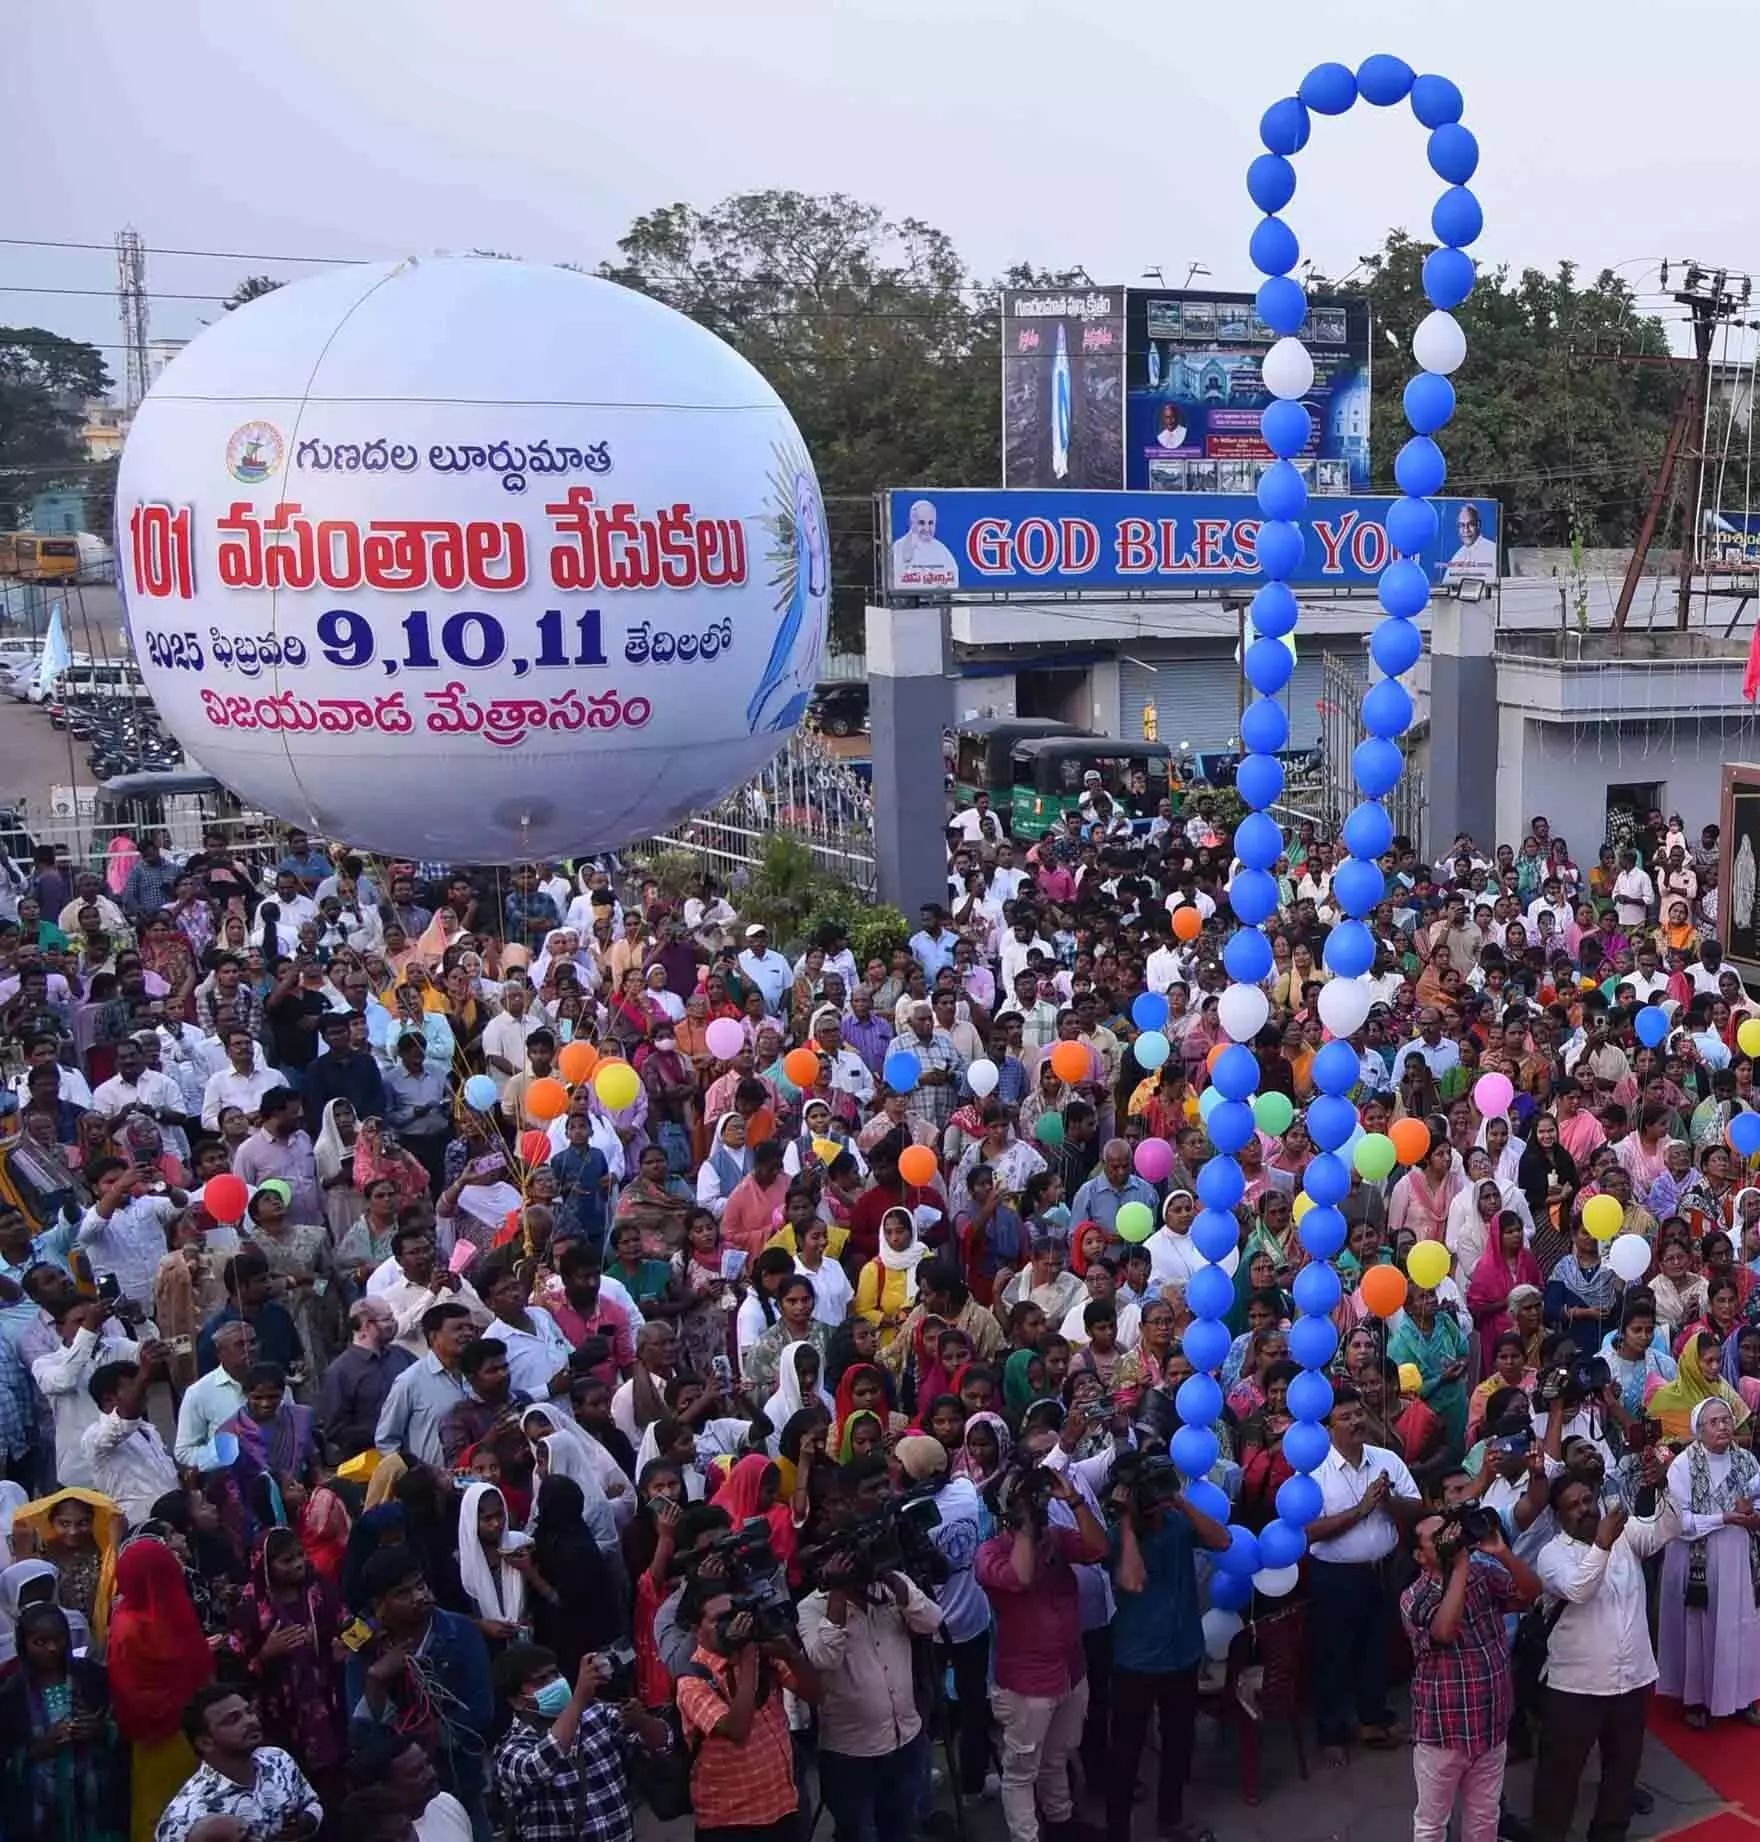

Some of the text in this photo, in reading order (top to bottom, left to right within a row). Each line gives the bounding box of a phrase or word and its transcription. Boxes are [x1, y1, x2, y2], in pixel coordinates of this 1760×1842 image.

[297, 438, 418, 472] గుణదల
[429, 439, 612, 492] లూర్దుమాత
[130, 485, 747, 600] 101 వసంతాల వేడుకలు
[966, 509, 1420, 576] GOD BLES YO
[146, 631, 205, 671] 2025
[209, 626, 307, 676] ఫిబ్రవరి
[200, 680, 652, 746] విజయవాడ మేత్రాసనం
